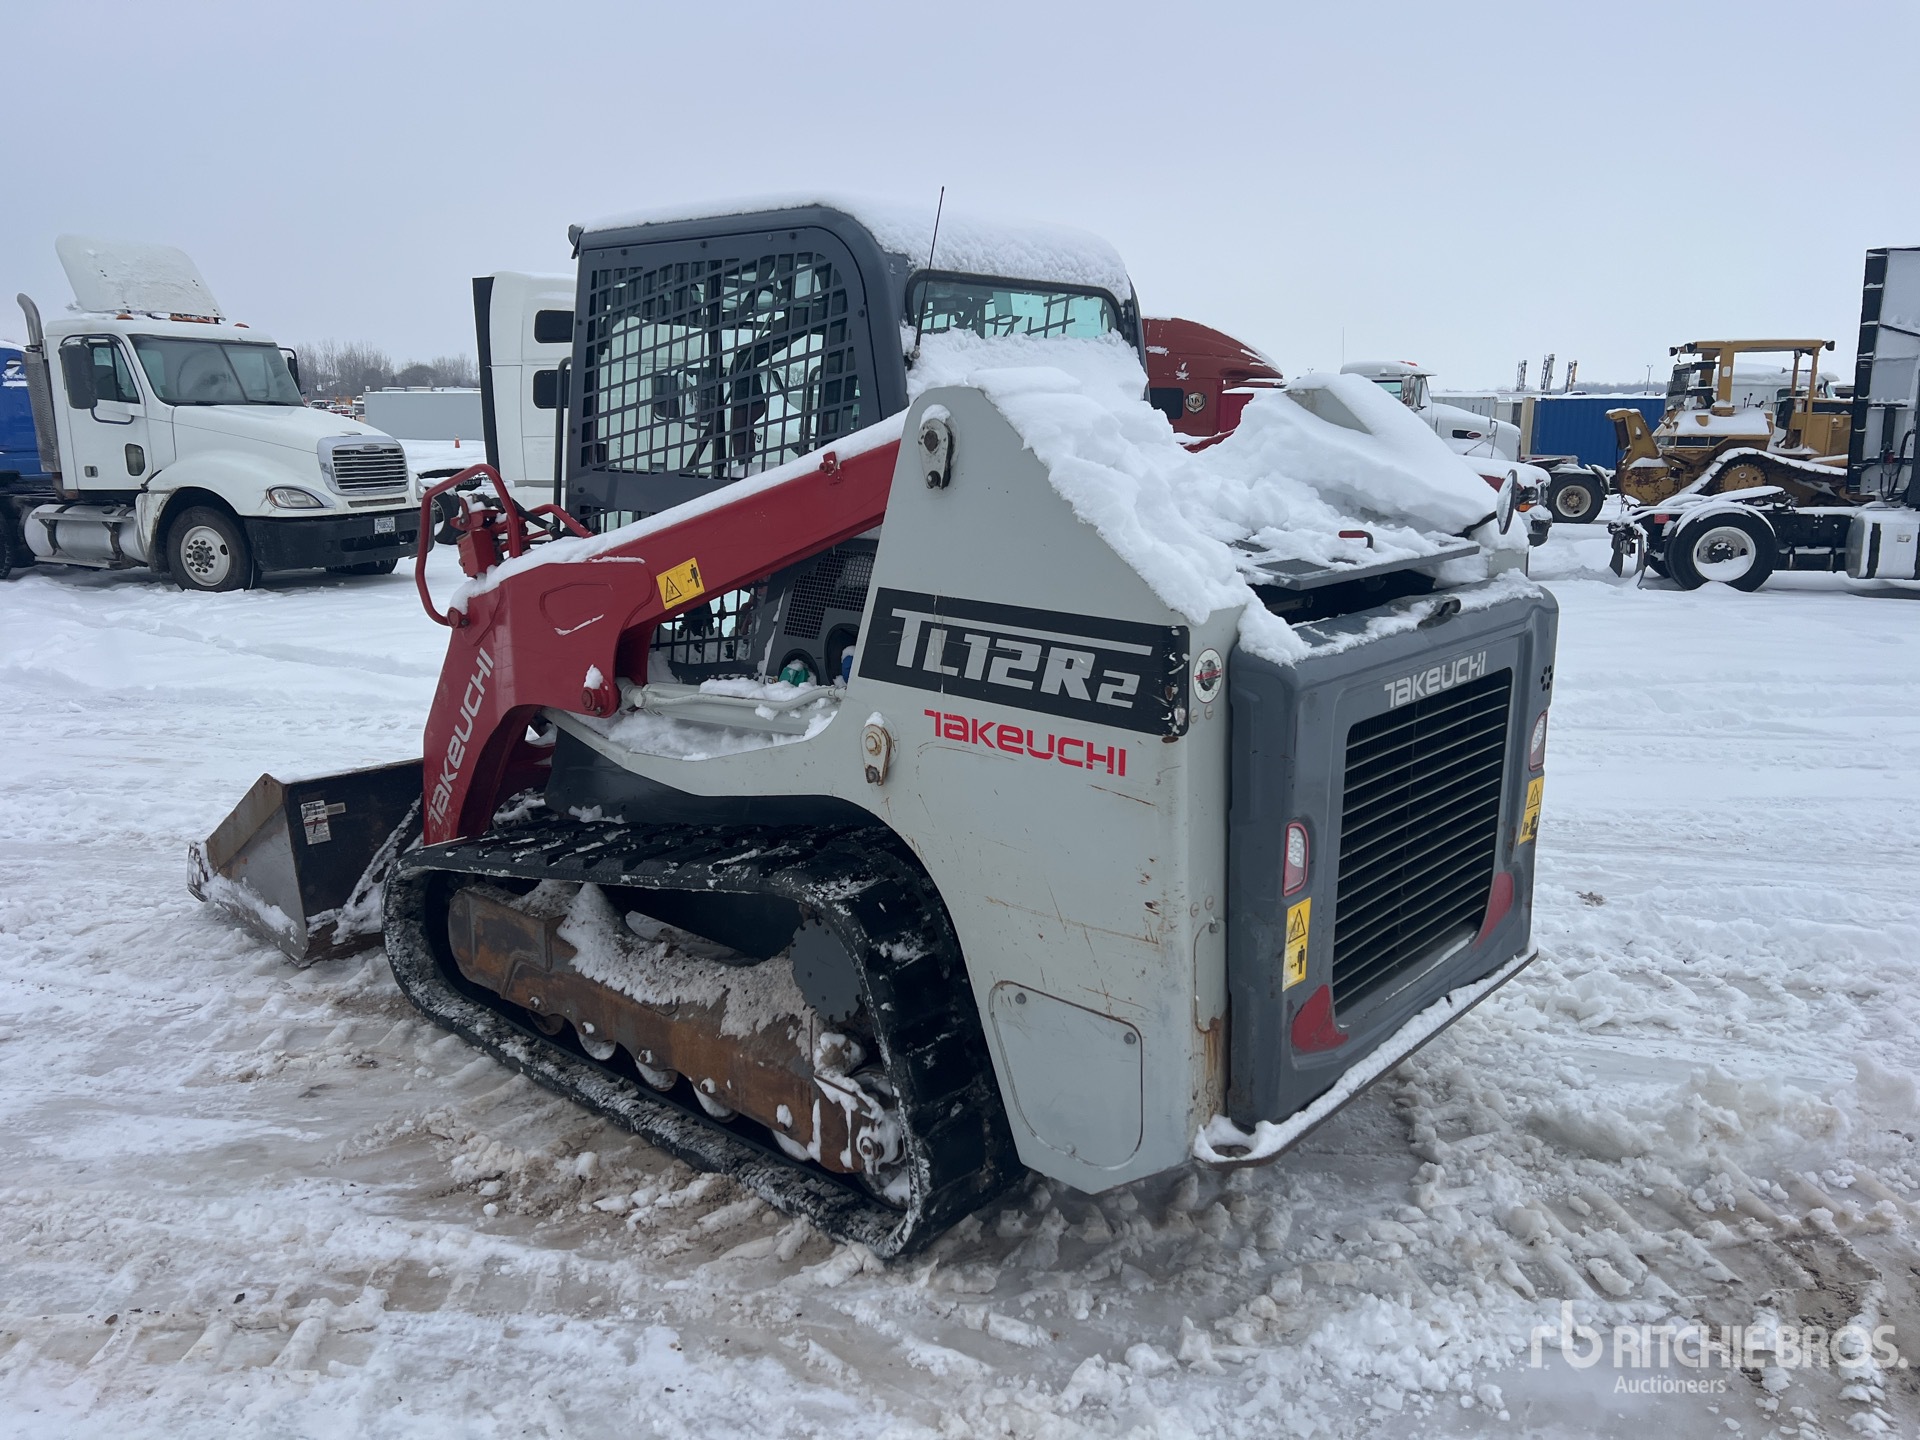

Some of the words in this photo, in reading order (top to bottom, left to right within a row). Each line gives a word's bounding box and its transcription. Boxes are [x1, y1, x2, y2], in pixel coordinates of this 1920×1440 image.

[1384, 651, 1486, 708] TAKEUCHI
[428, 648, 494, 825] TAKEUCHI
[924, 709, 1126, 776] TAKEUCHI
